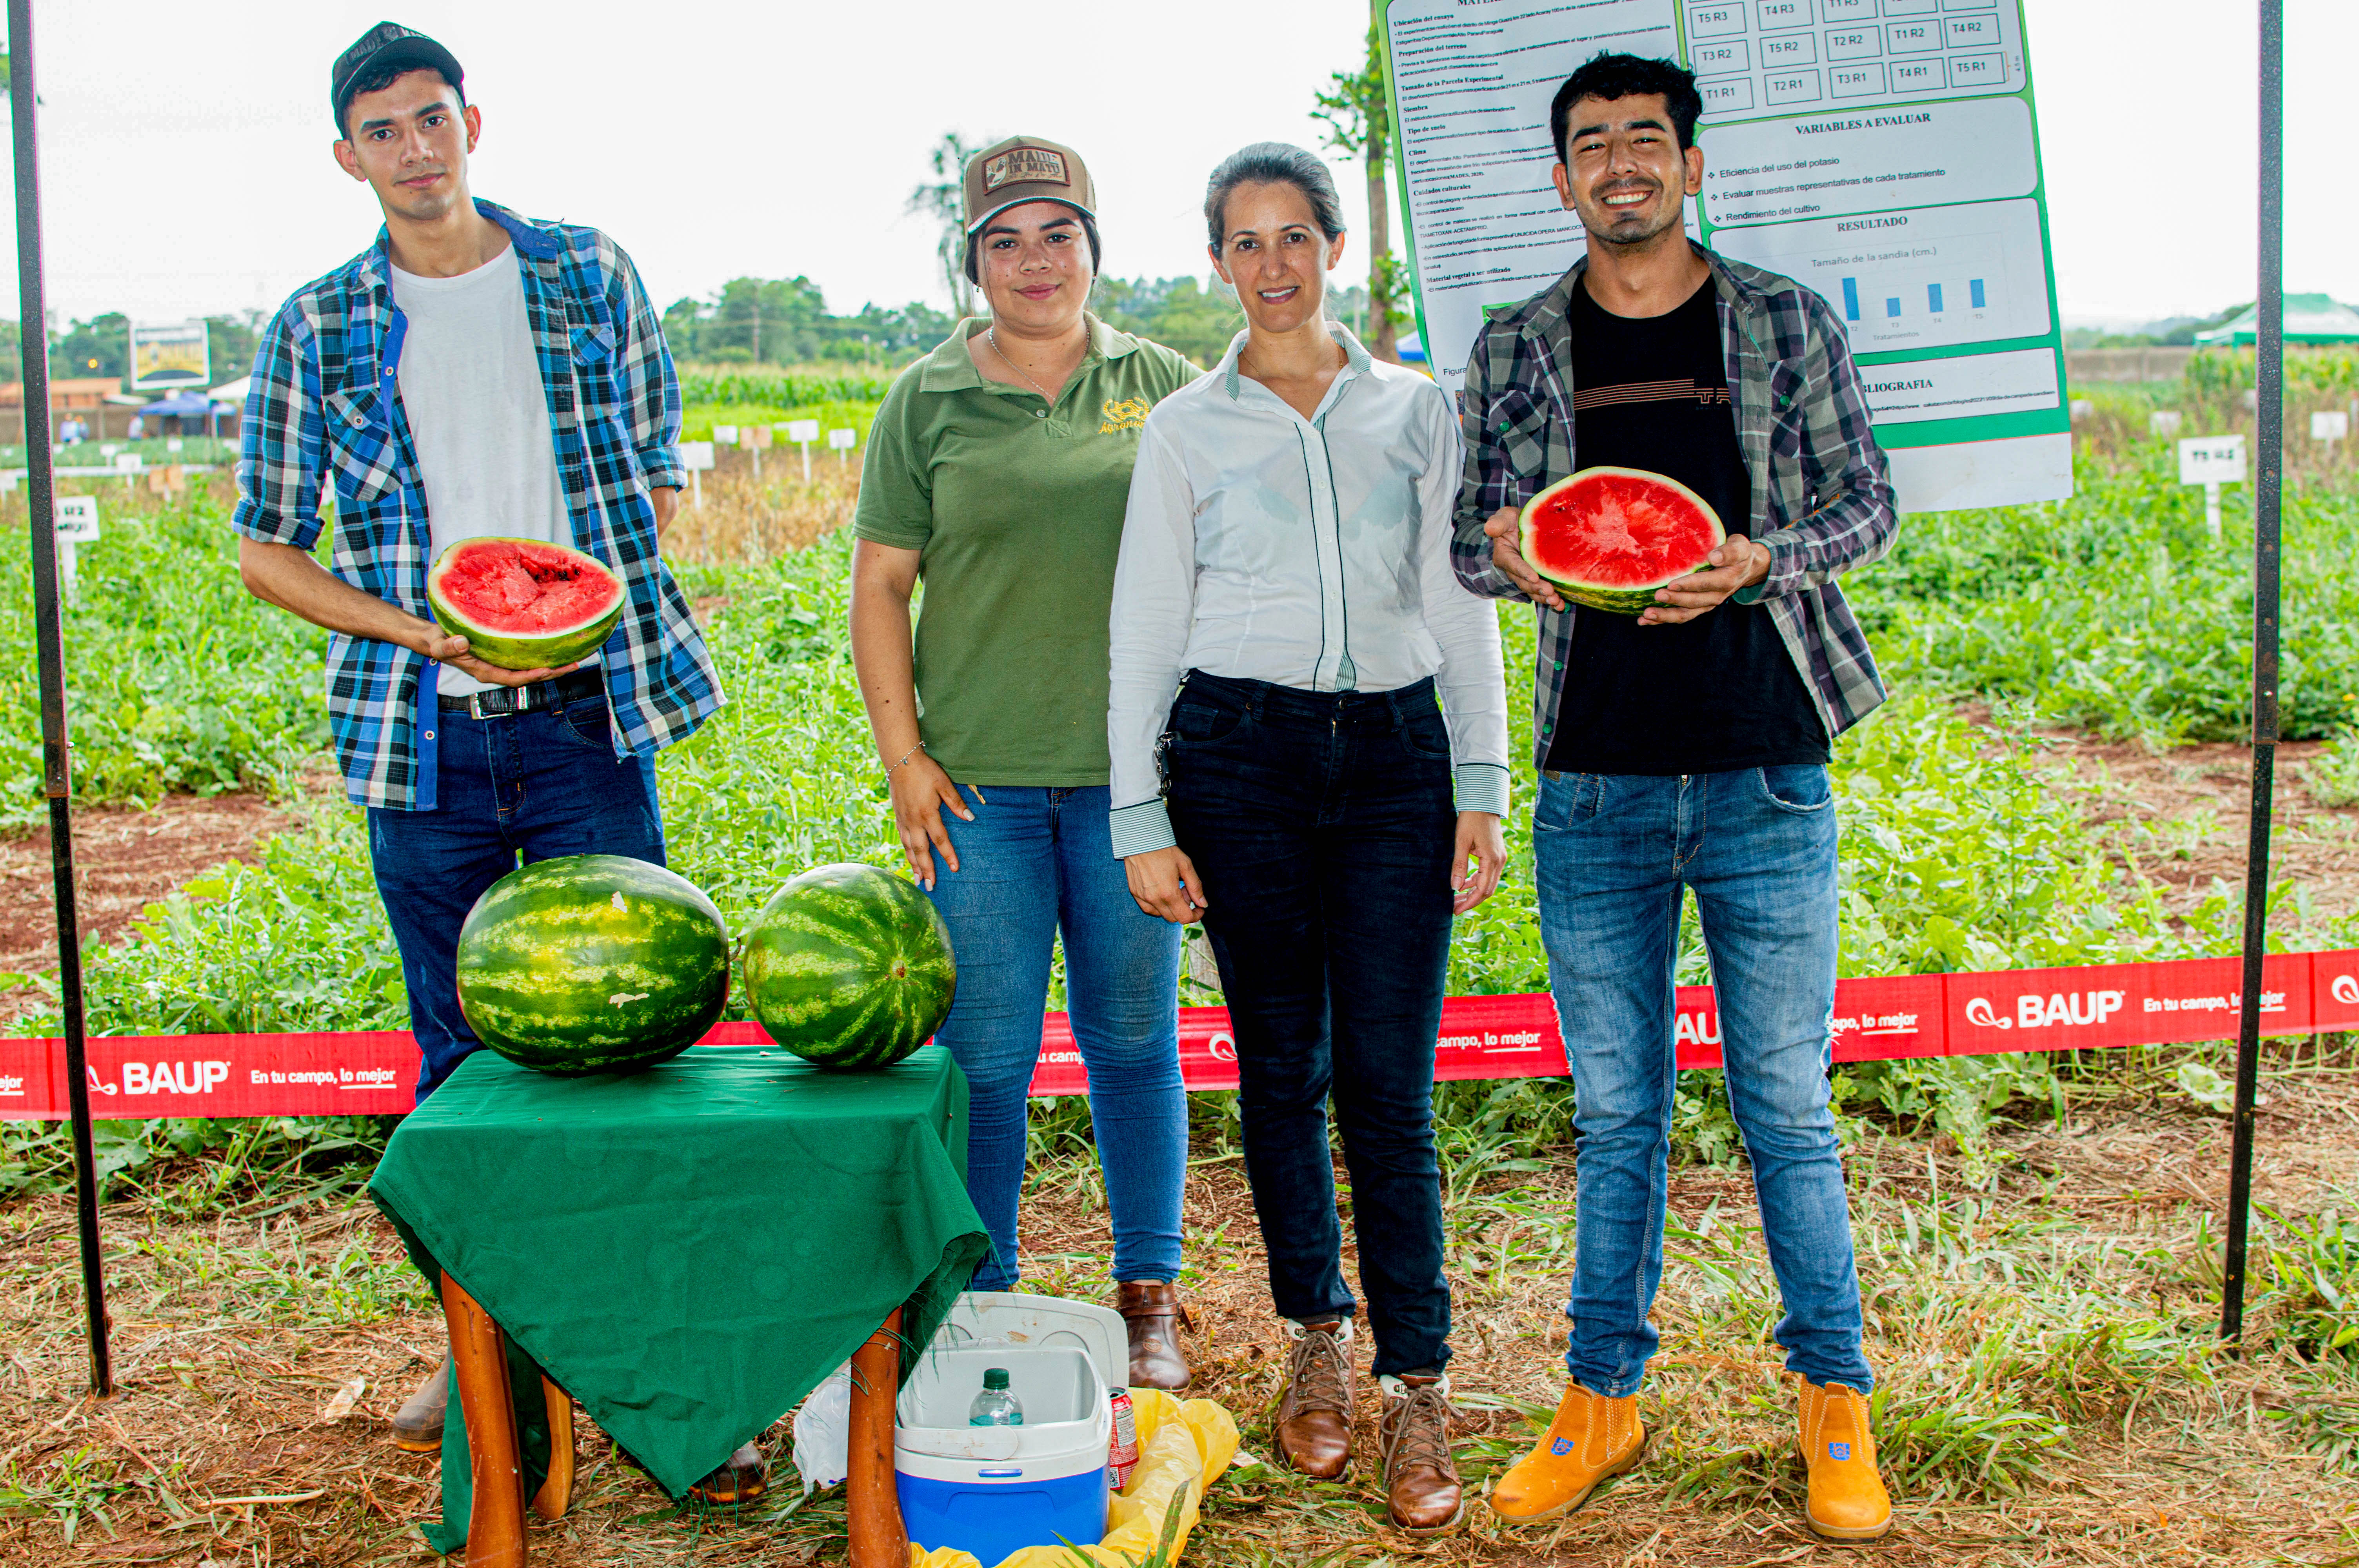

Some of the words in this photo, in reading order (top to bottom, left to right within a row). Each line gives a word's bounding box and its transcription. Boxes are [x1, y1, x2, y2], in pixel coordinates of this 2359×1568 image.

[1765, 6, 1777, 15] T4
[1780, 4, 1794, 13] R3
[1394, 17, 1422, 27] Ubicación
[1698, 14, 1711, 23] T5
[1714, 12, 1728, 21] R3
[1895, 29, 1907, 38] T1
[1911, 28, 1924, 37] R2
[1952, 24, 1965, 33] T4
[1968, 22, 1981, 31] R2
[1833, 37, 1846, 46] T2
[1849, 35, 1863, 44] R2
[1398, 47, 1434, 58] Preparación
[1445, 42, 1467, 51] terreno
[1768, 44, 1781, 53] T5
[1785, 42, 1798, 51] R2
[1702, 51, 1715, 60] T3
[1718, 49, 1732, 58] R2
[1898, 69, 1911, 78] T4
[1914, 67, 1927, 76] R1
[1957, 63, 1969, 72] T5
[1973, 62, 1986, 71] R1
[1401, 83, 1425, 91] Tamaño
[1441, 77, 1463, 86] Parcela
[1464, 72, 1503, 85] Experimental
[1837, 74, 1850, 83] T3
[1853, 73, 1866, 82] R1
[1774, 82, 1786, 91] T2
[1789, 80, 1803, 89] R1
[1706, 89, 1718, 99] T1
[1722, 87, 1735, 97] R1
[1403, 104, 1428, 113] Siembra
[1796, 119, 1862, 135] VARIABLES
[1865, 118, 1873, 128] A
[1875, 113, 1931, 127] EVALUAR
[1007, 151, 1059, 164] MADE
[1009, 163, 1022, 173] IN
[1720, 167, 1759, 178] Eficiencia
[1762, 164, 1774, 172] del
[1809, 157, 1839, 168] potasio
[1413, 187, 1441, 196] Cuidados
[1441, 183, 1471, 192] culturales
[1723, 189, 1754, 200] Evaluar
[1756, 185, 1794, 196] muestras
[1797, 177, 1861, 192] representativas
[1863, 175, 1873, 183] de
[1876, 172, 1896, 182] cada
[1898, 169, 1946, 180] tratamiento
[1726, 210, 1777, 221] Rendimiento
[1794, 205, 1820, 214] cultivo
[1837, 216, 1908, 232] RESULTADO
[1811, 257, 1849, 267] Tamaño
[1852, 255, 1863, 263] de
[1878, 250, 1909, 260] sandia
[1912, 247, 1937, 258] (cm.)
[1426, 274, 1451, 283] Material
[1452, 272, 1471, 280] vegetal
[1486, 266, 1510, 275] utilizado
[1873, 331, 1920, 341] Tratamientos
[1443, 368, 1466, 377] Figura
[2018, 991, 2123, 1028] BAUP
[2144, 998, 2162, 1012] En
[2163, 998, 2179, 1011] tu
[2180, 996, 2229, 1012] campo,
[1862, 1014, 1876, 1028] lo
[1878, 1012, 1918, 1029] mejor
[1675, 1013, 1721, 1046] AU
[1485, 1032, 1498, 1045] lo
[1501, 1031, 1541, 1047] mejor
[123, 1061, 228, 1095] BAUP
[251, 1070, 269, 1084] En
[271, 1071, 285, 1083] tu
[288, 1071, 338, 1085] campo,
[340, 1068, 354, 1082] lo
[356, 1067, 396, 1084] mejor
